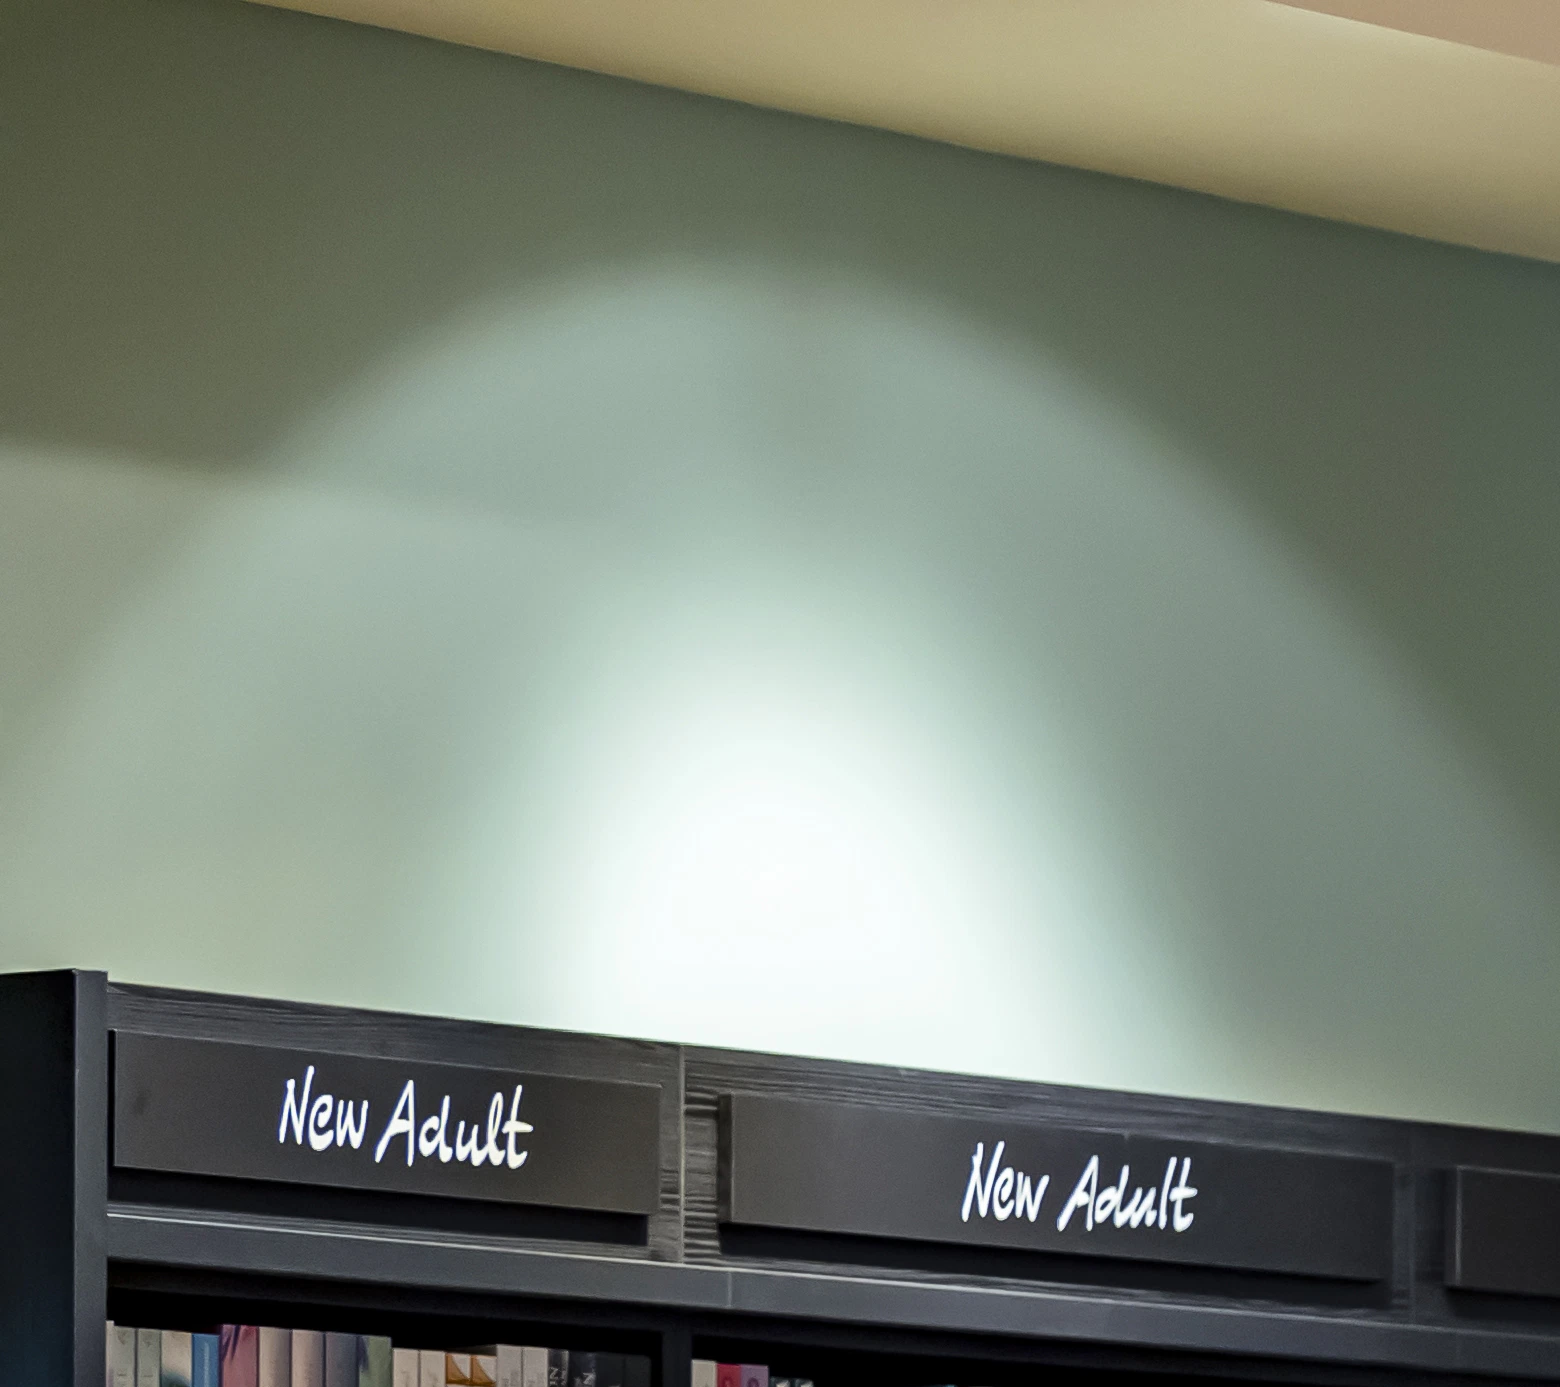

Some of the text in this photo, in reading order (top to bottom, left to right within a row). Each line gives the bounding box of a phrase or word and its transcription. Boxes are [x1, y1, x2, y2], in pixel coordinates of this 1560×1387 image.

[279, 1065, 533, 1169] New Adult
[962, 1141, 1198, 1232] New Adult
